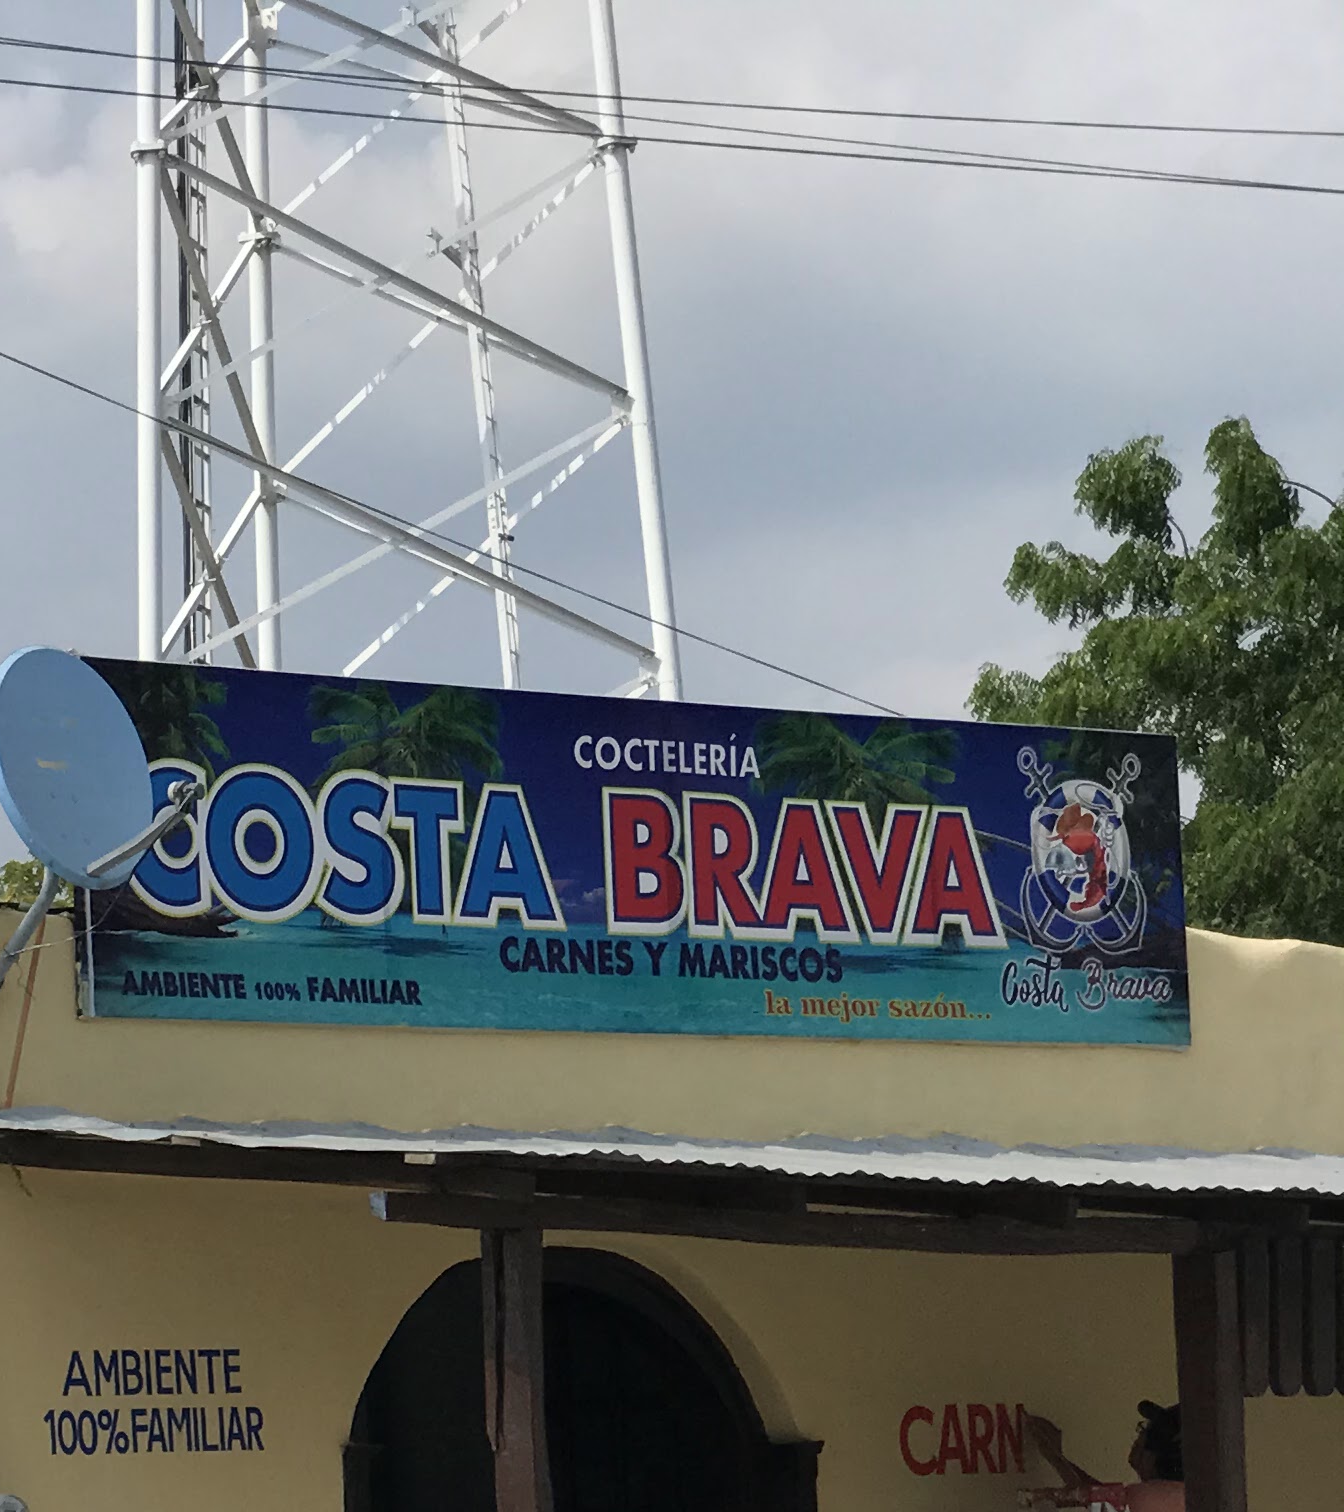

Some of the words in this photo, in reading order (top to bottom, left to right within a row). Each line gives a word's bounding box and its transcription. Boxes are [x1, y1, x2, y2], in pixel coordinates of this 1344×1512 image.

[573, 733, 761, 779] COCTELERÍA
[130, 757, 567, 931] COSTA
[601, 786, 1009, 949] BRAVA
[499, 936, 633, 976] CARNES
[645, 942, 668, 976] Y
[677, 942, 844, 983] MARISCOS
[1001, 953, 1069, 1013] Costa
[1077, 957, 1174, 1011] Brava
[122, 970, 247, 999] AMBIENTE
[254, 981, 301, 1001] 100%
[306, 976, 423, 1006] FAMILIAR
[764, 988, 792, 1016] la
[801, 992, 880, 1023] mejor
[62, 1349, 242, 1397] AMBIENTE
[899, 1403, 1025, 1476] CARN
